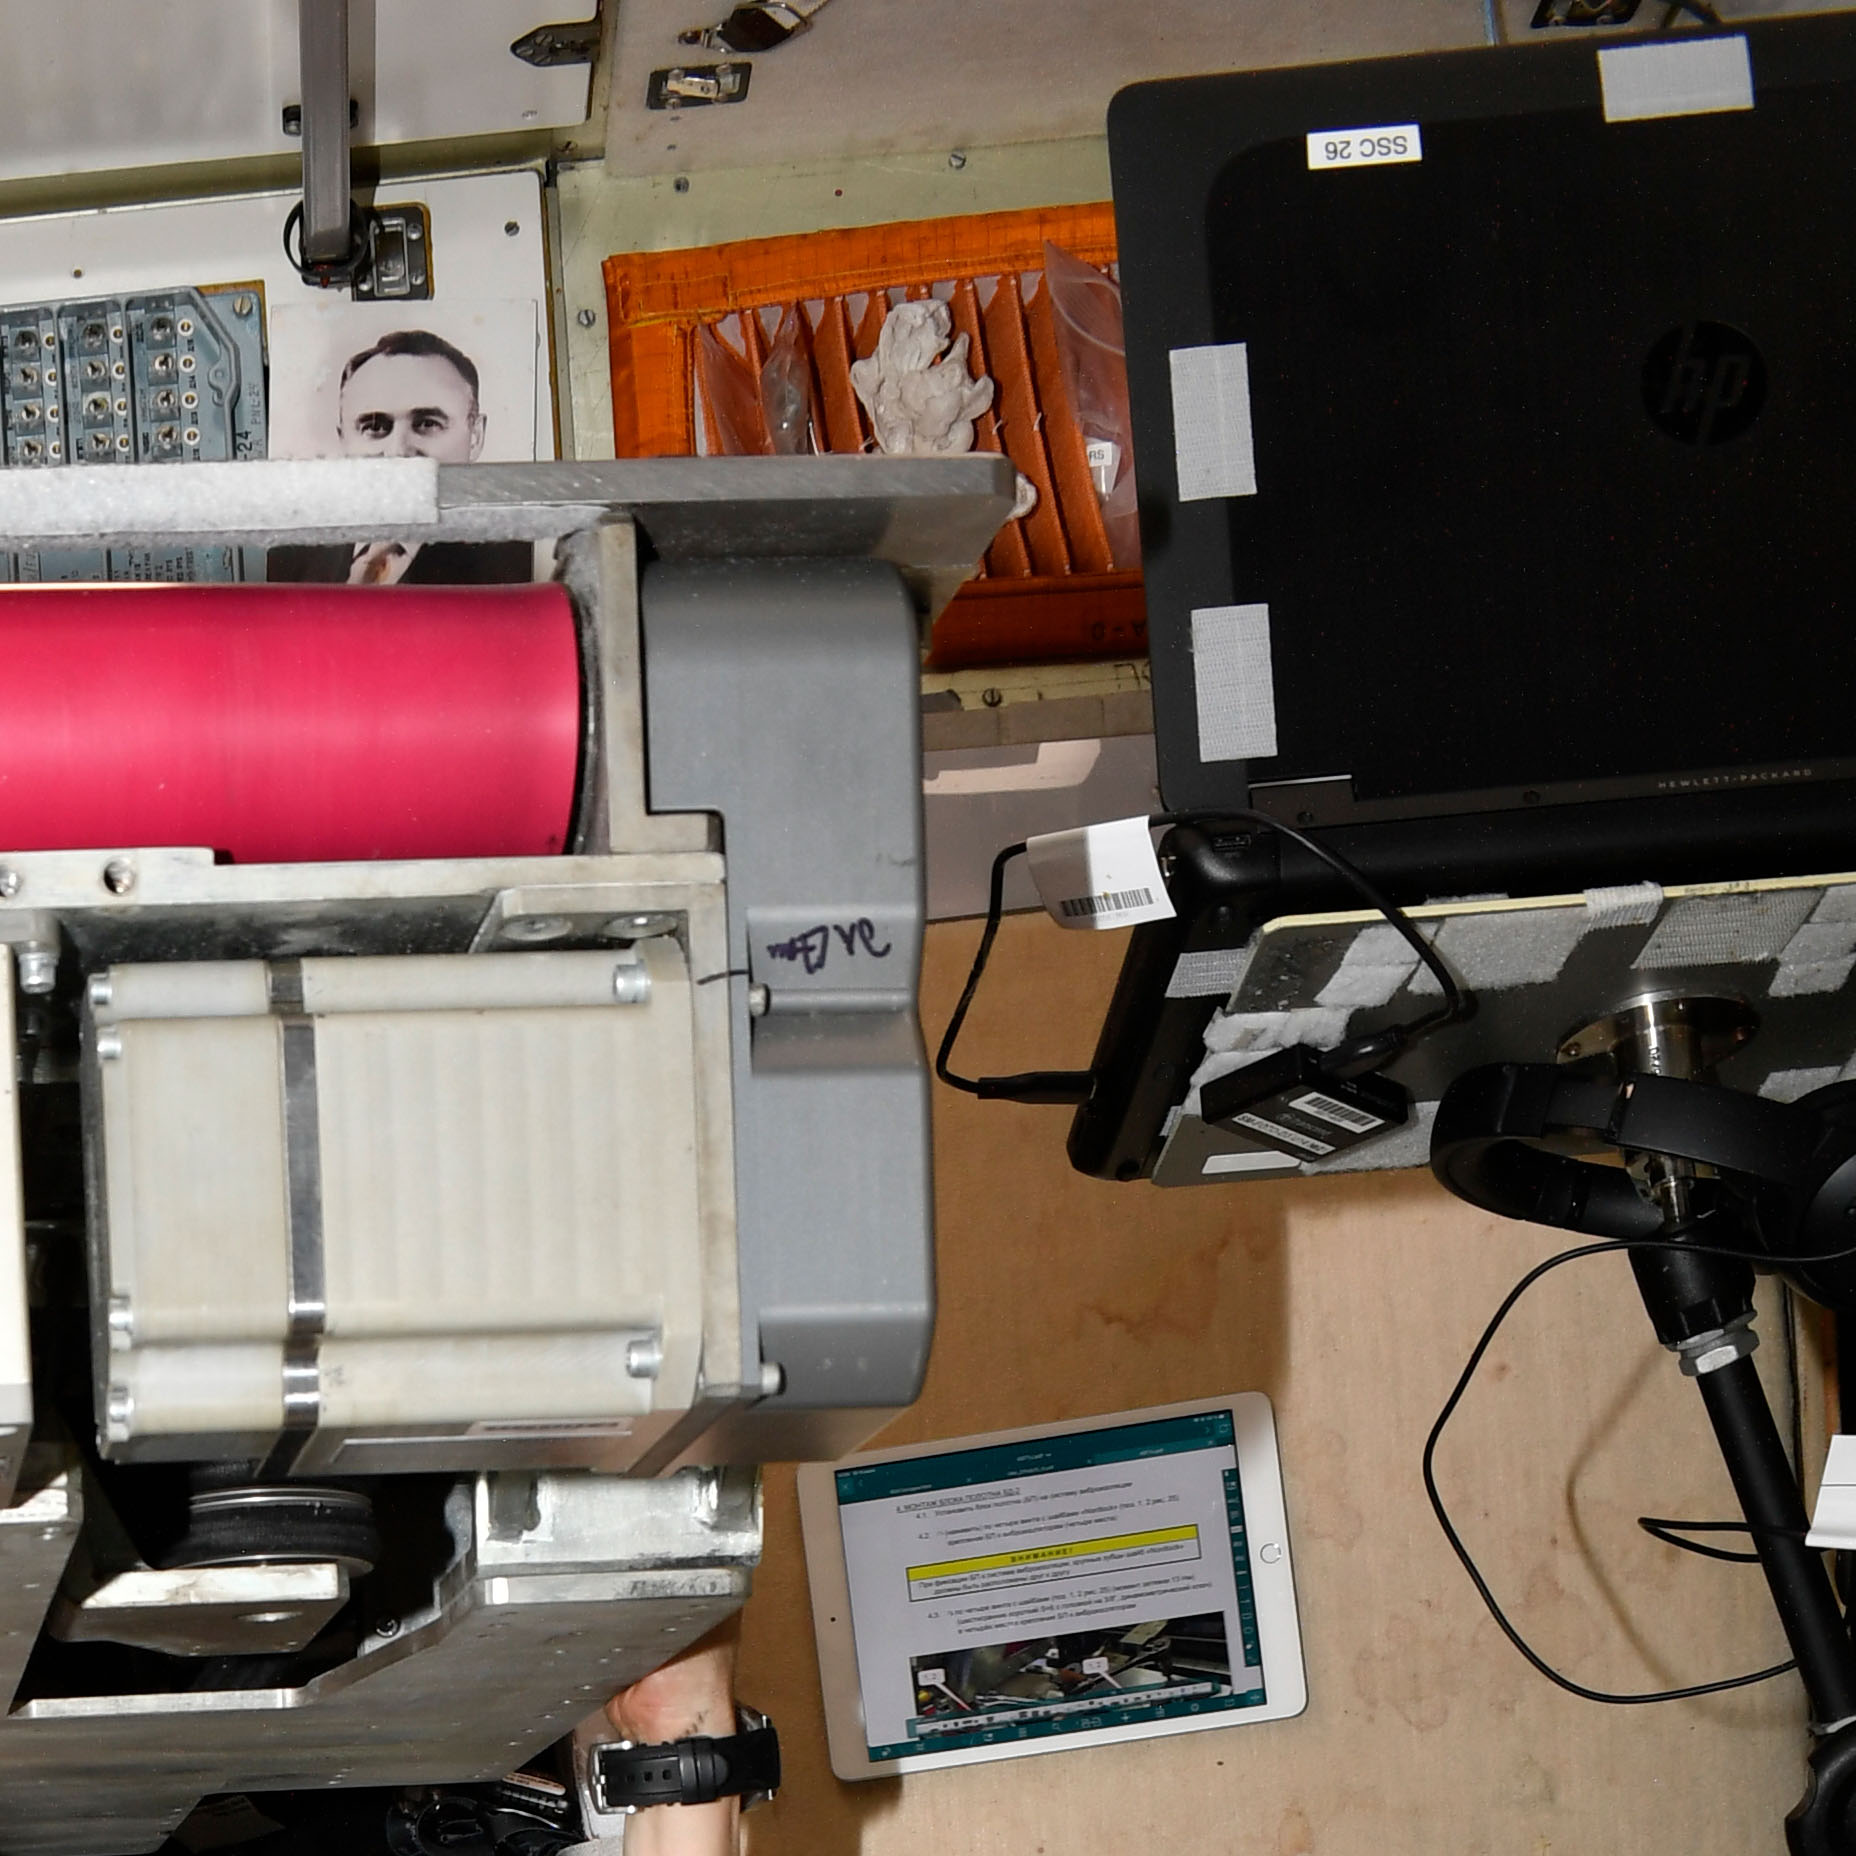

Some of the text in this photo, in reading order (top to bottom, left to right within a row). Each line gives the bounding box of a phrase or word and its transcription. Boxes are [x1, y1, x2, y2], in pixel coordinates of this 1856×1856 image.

[1324, 135, 1409, 161] SSC 26
[1658, 768, 1812, 789] HEWLETT-PACKARD
